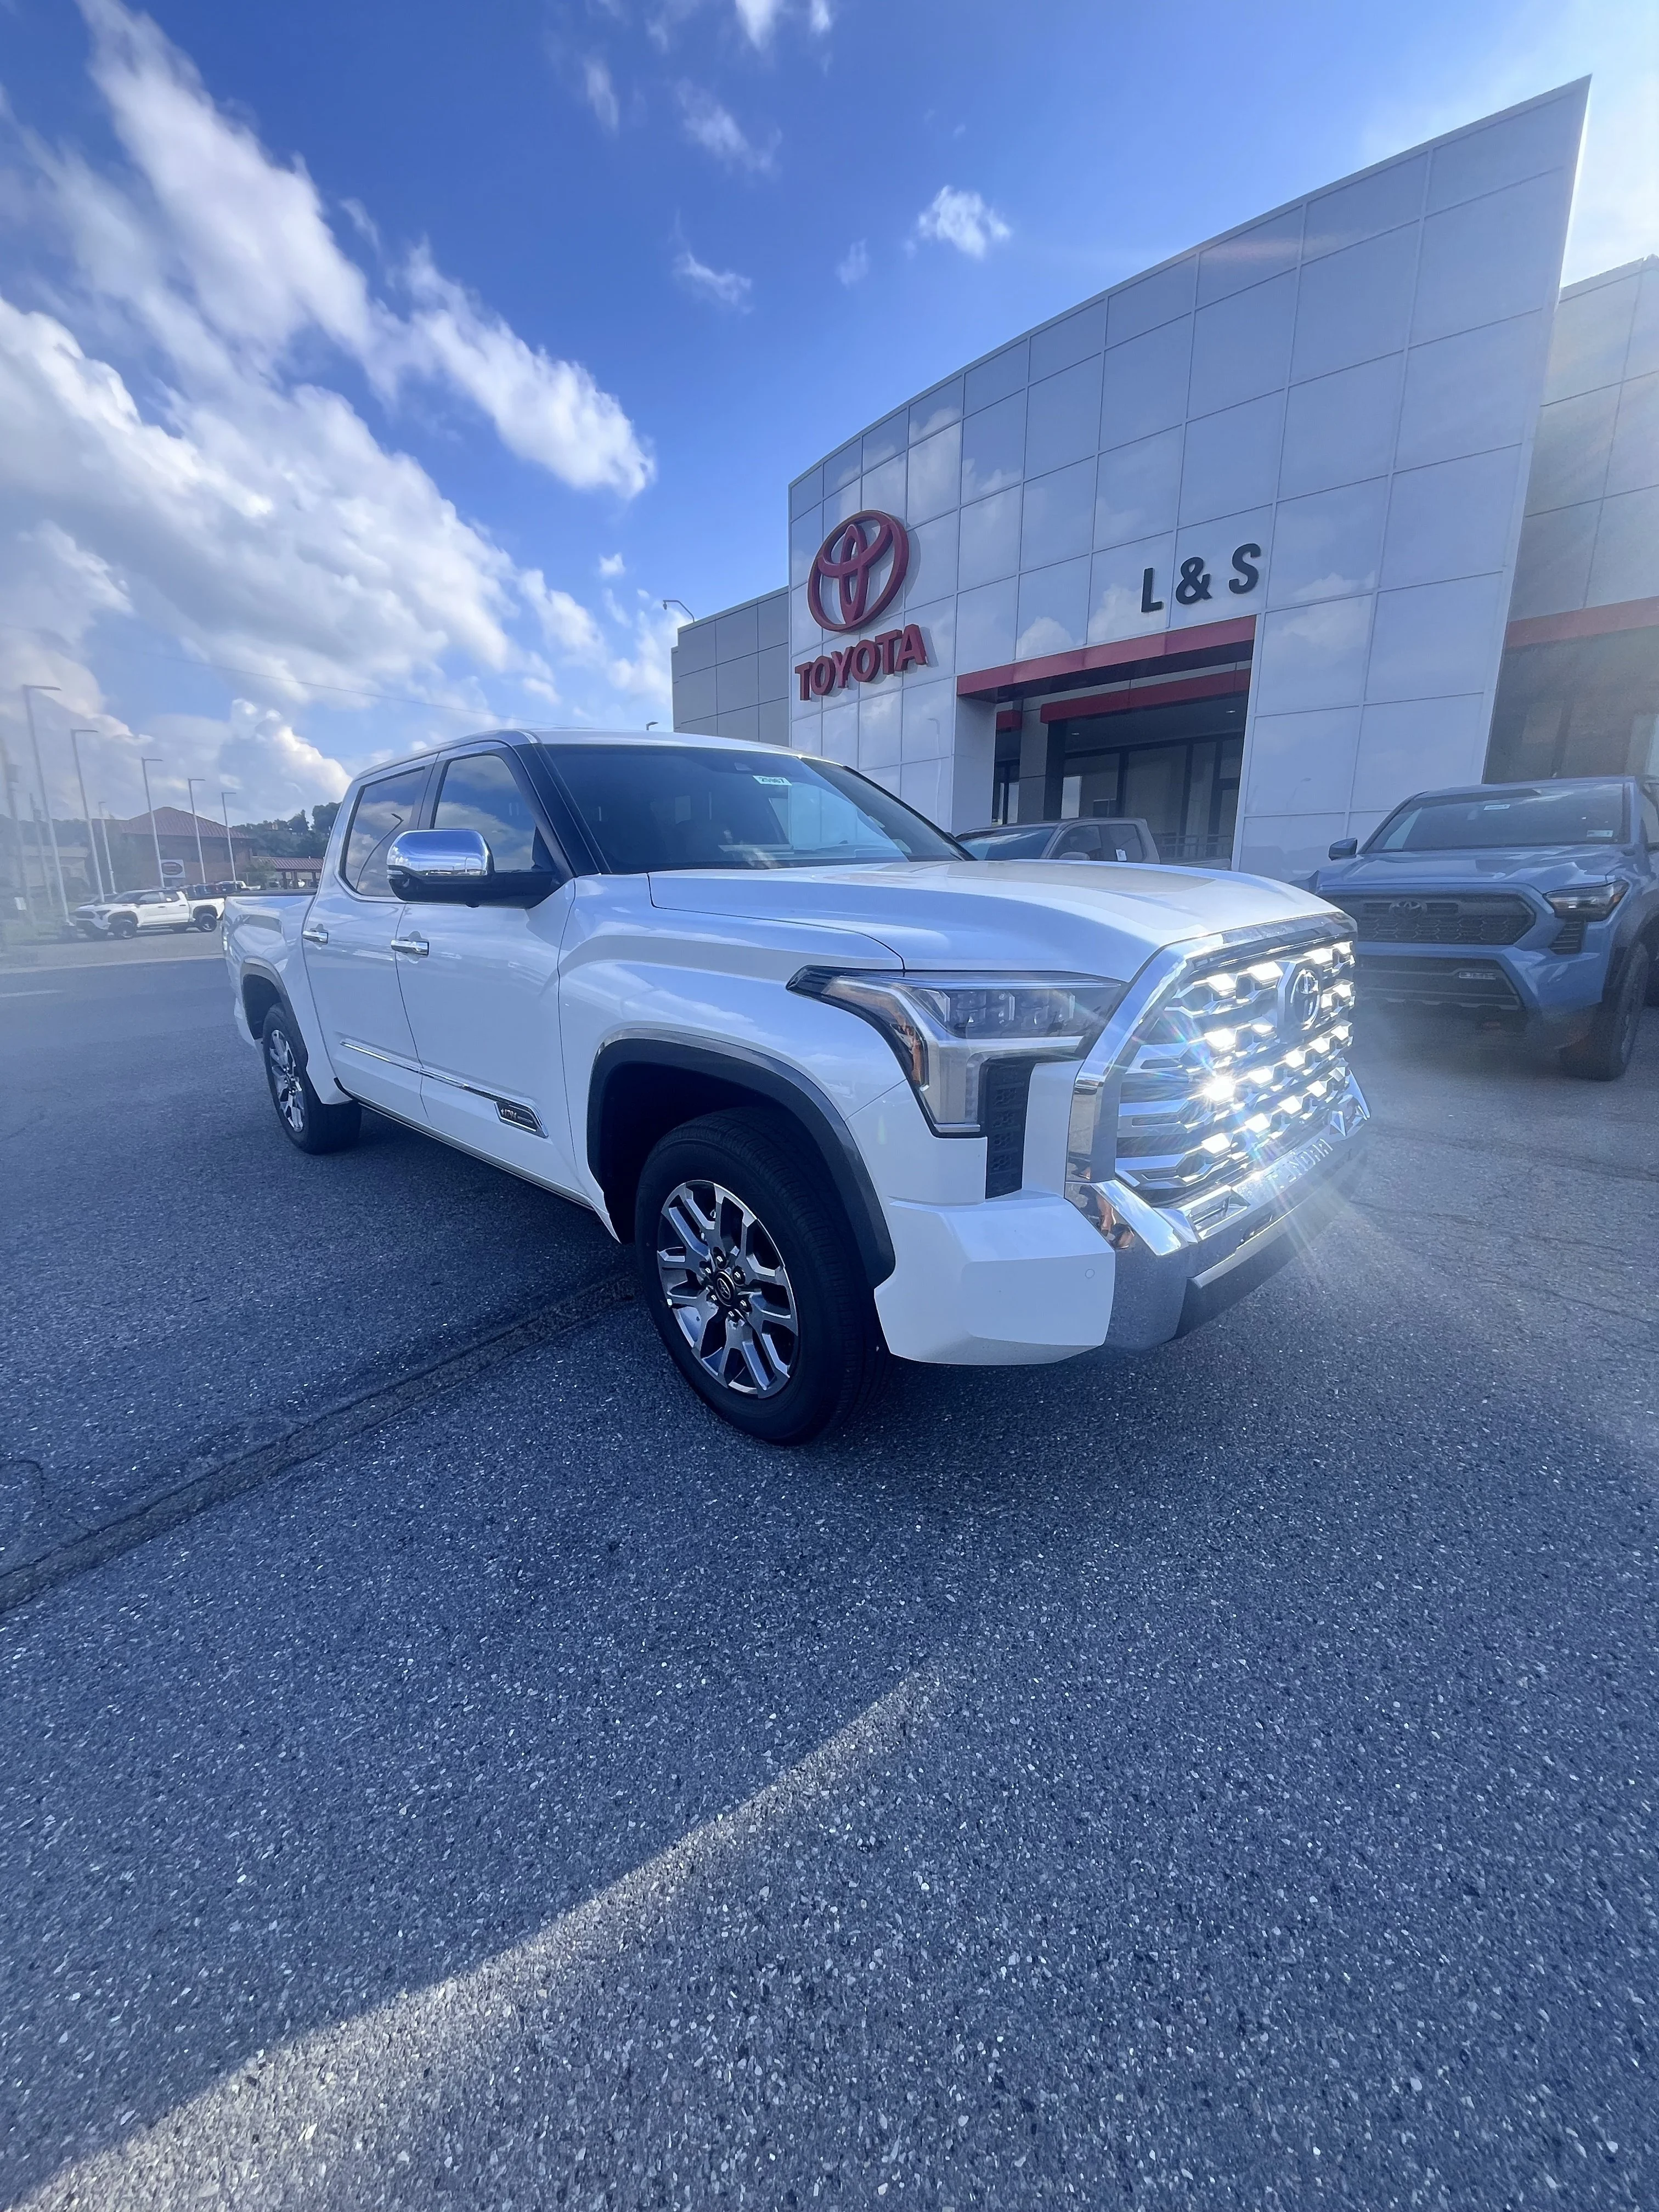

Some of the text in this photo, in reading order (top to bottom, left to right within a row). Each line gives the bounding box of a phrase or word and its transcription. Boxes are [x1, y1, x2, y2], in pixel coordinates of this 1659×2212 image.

[1141, 543, 1261, 612] L & S
[794, 623, 928, 701] TOYOTA
